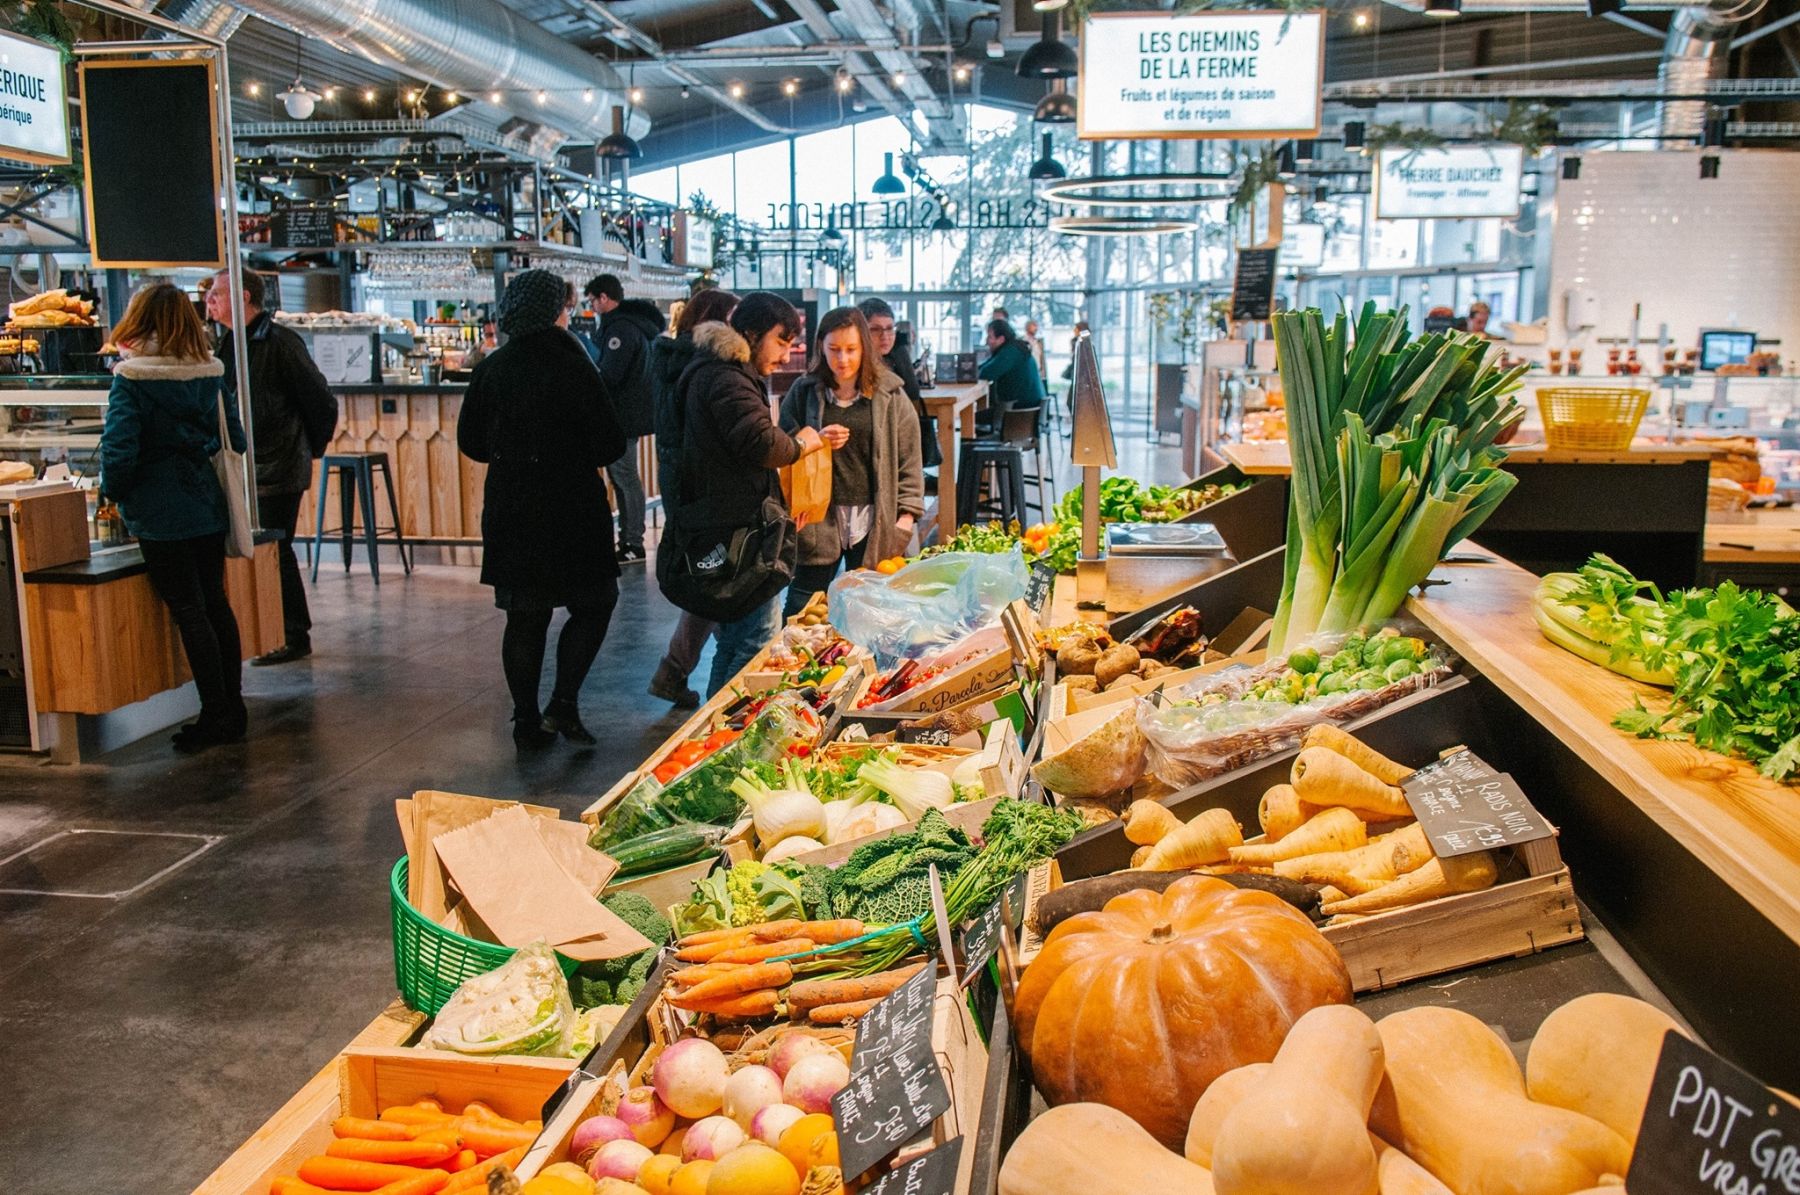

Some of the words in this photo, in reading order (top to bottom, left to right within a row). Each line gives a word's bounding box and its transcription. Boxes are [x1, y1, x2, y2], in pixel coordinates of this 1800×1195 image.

[1139, 31, 1172, 53] LES
[1178, 30, 1261, 52] CHEMINS
[1139, 58, 1163, 79] DE
[1169, 58, 1190, 79] LA
[1197, 56, 1258, 78] FERME
[1120, 88, 1153, 102] Fruits
[1156, 88, 1167, 102] et
[1170, 87, 1217, 105] légumes
[1221, 87, 1235, 101] de
[1238, 87, 1276, 101] saison
[1164, 108, 1175, 121] et
[1177, 107, 1192, 121] de
[1194, 106, 1232, 123] région
[1418, 790, 1446, 817] FRANCE
[1475, 781, 1513, 813] RADIS
[1498, 809, 1535, 836] NOIR
[887, 1040, 918, 1078] Navet
[1669, 1065, 1754, 1149] PDT
[903, 1157, 927, 1195] Butt
